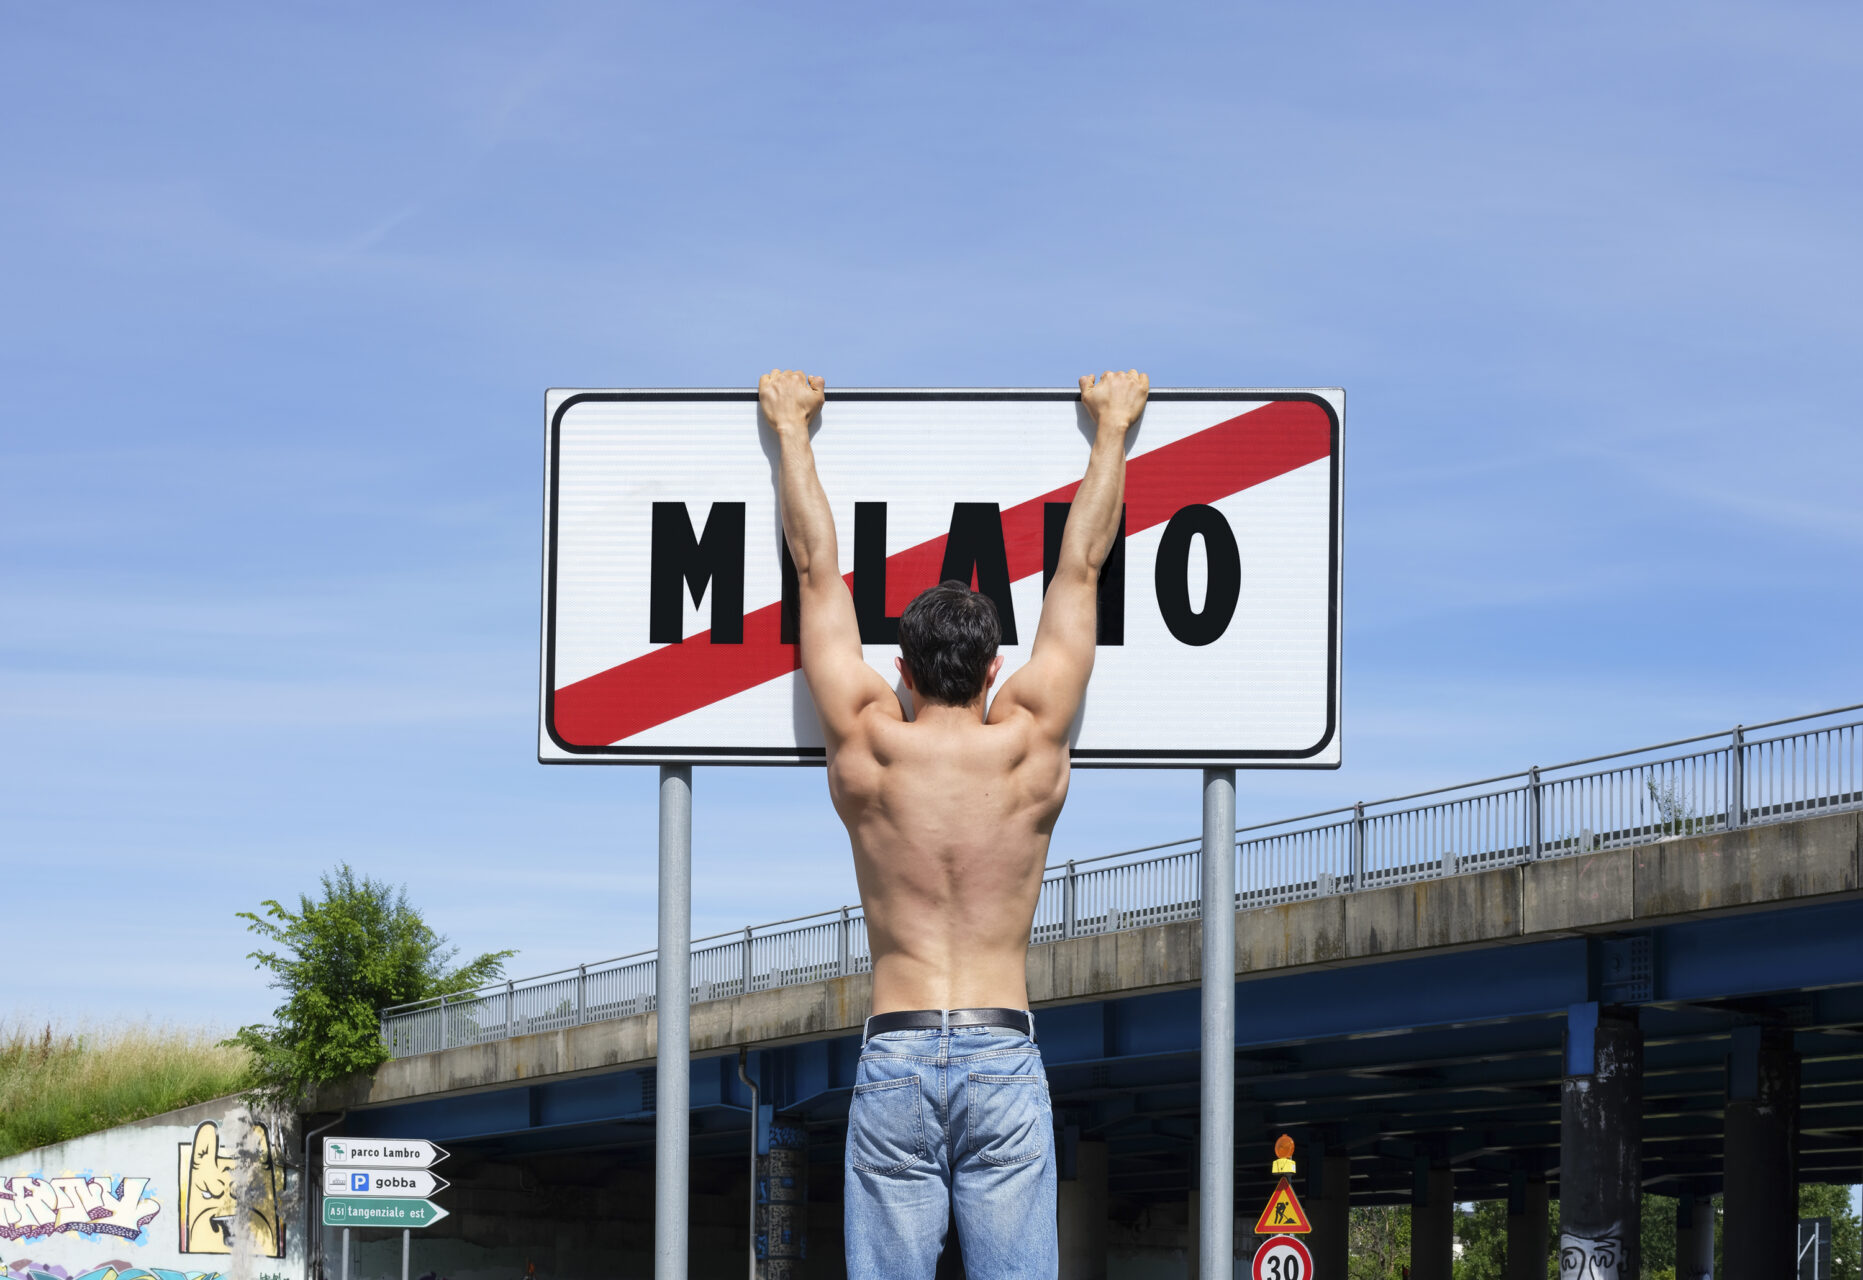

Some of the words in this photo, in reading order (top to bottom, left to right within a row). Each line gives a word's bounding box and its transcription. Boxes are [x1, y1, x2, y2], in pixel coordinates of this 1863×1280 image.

[351, 1148, 379, 1159] parco
[354, 1175, 366, 1190] P
[375, 1177, 416, 1189] gobba
[348, 1205, 405, 1219] tangenziale
[409, 1207, 425, 1219] est
